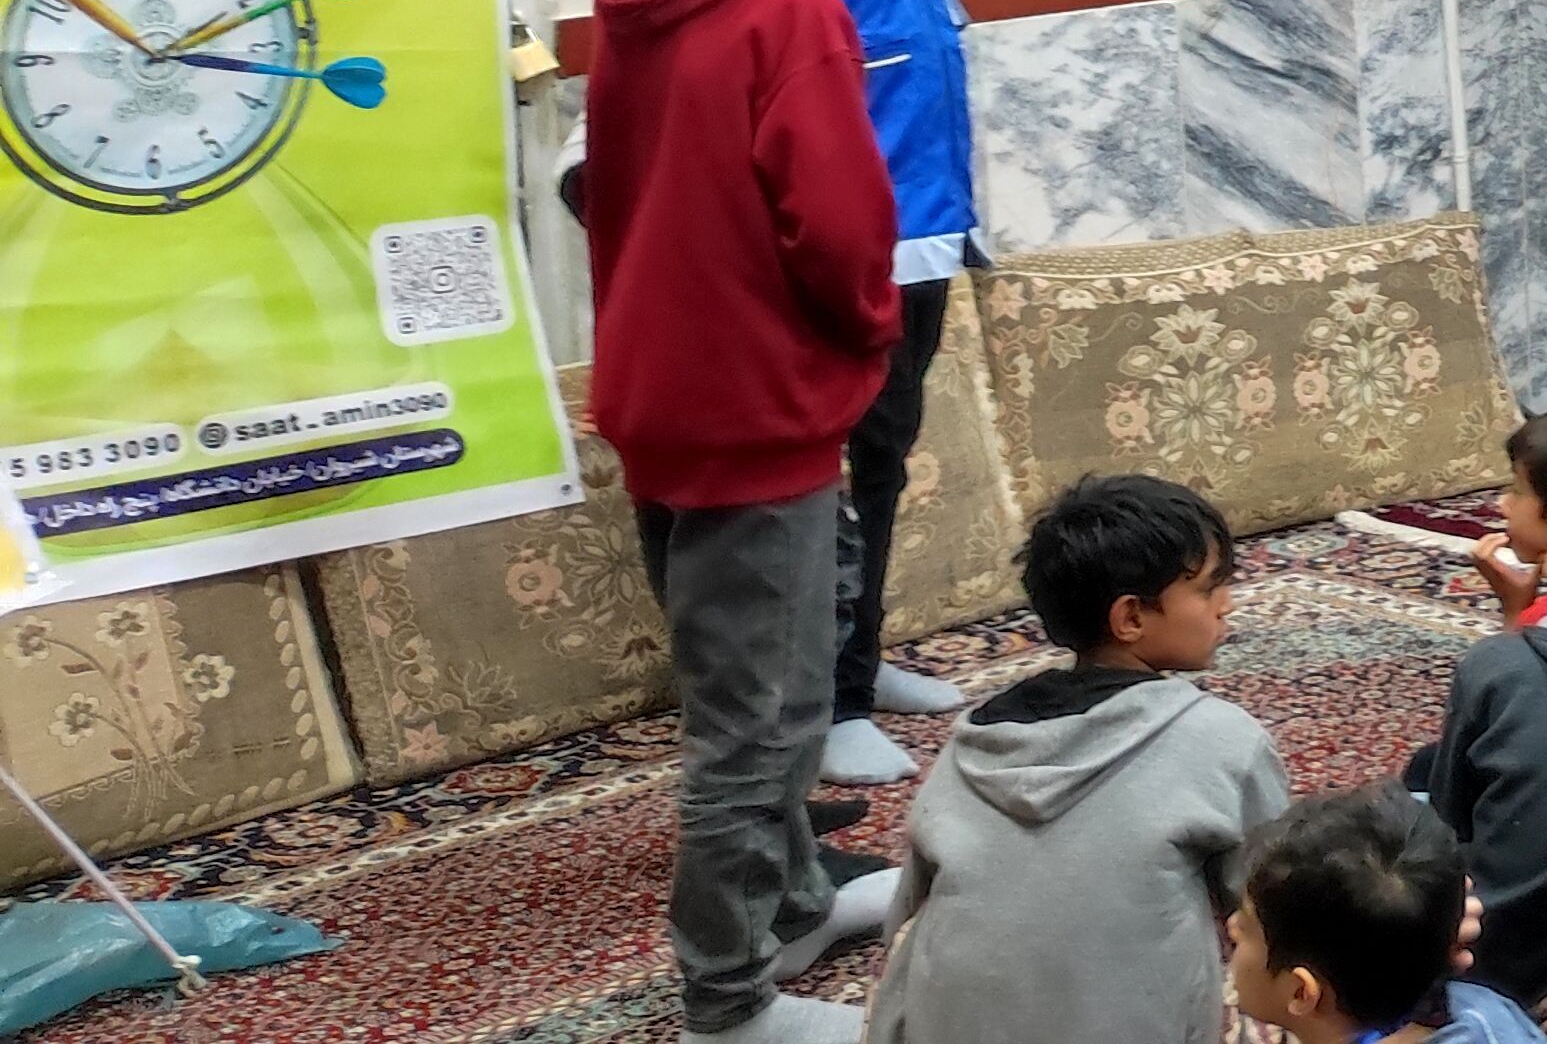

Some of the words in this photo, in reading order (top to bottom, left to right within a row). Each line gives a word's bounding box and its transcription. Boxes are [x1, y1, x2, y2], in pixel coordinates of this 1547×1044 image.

[13, 53, 55, 68] 9
[249, 40, 285, 55] 3
[234, 90, 268, 110] 4
[31, 103, 71, 129] 8
[83, 135, 109, 169] 7
[197, 127, 227, 159] 5
[146, 144, 162, 180] 6
[36, 447, 95, 475] 983
[104, 433, 181, 463] 3090
